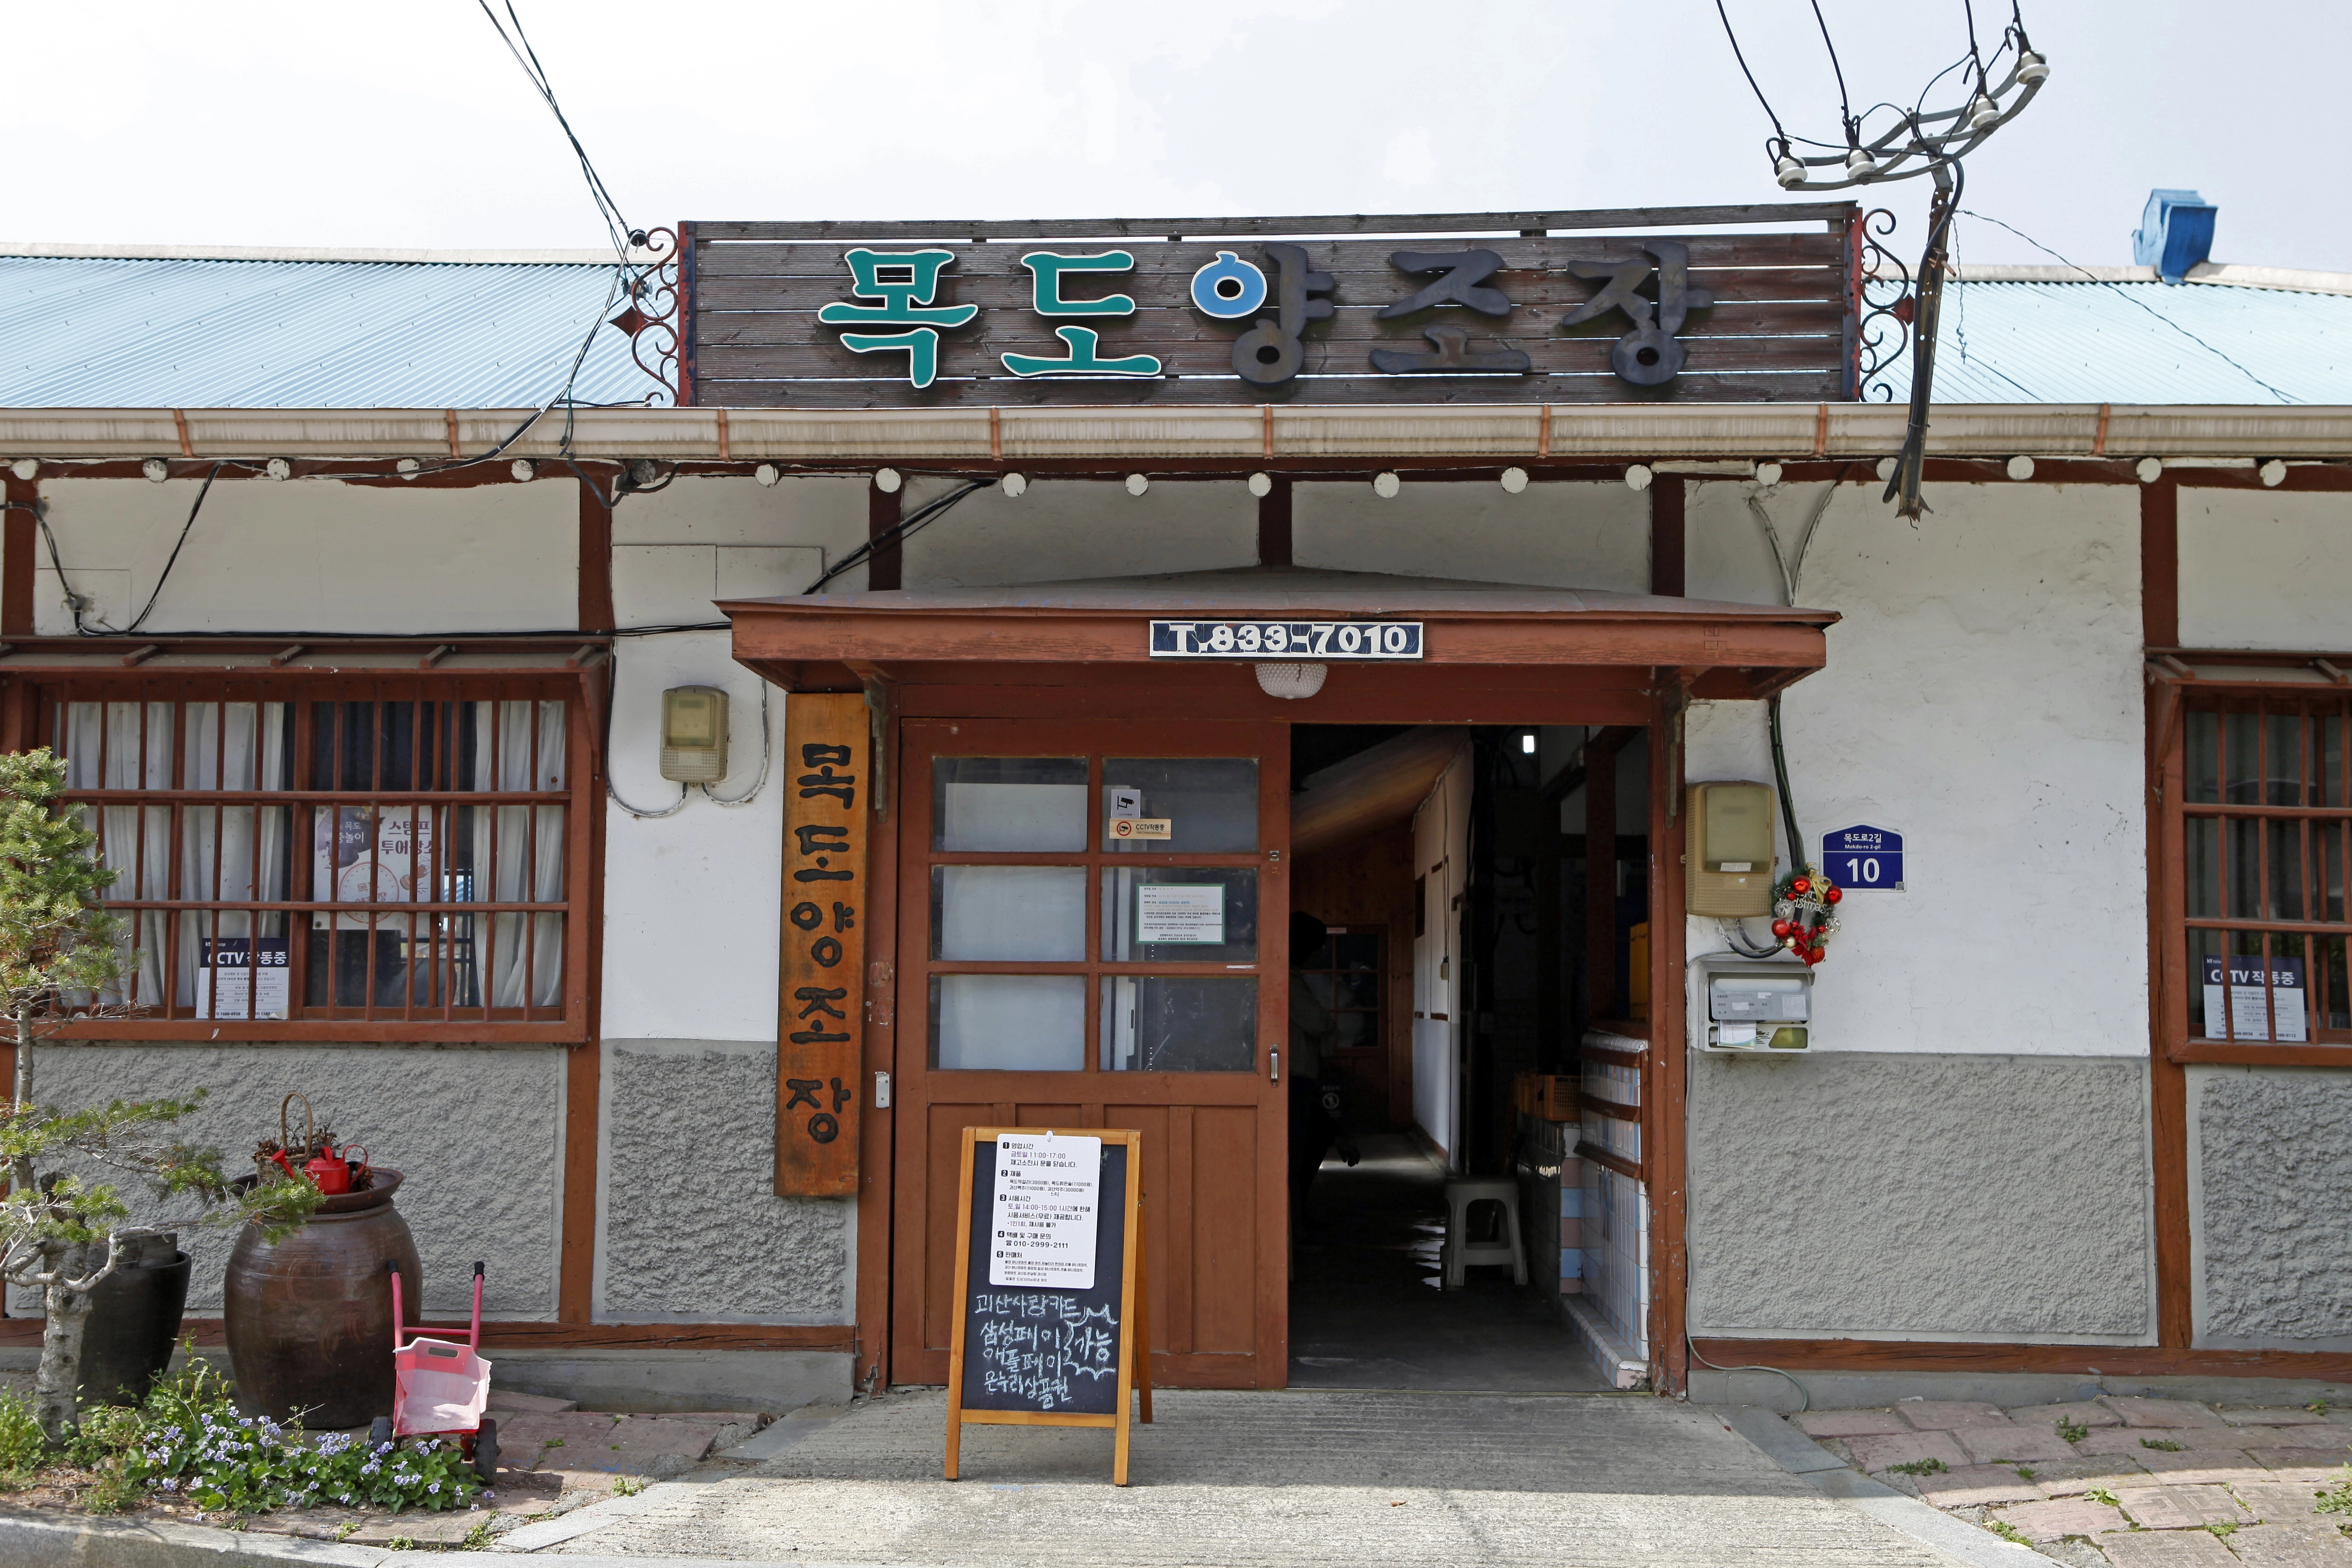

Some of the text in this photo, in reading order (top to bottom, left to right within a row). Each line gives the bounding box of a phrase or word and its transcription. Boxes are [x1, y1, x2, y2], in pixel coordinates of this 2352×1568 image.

[818, 242, 1714, 389] 목도양조장
[345, 821, 361, 831] 목도
[1844, 834, 1882, 843] 목도로2길
[1846, 858, 1880, 882] 10
[1795, 897, 1827, 914] istmas
[2211, 969, 2249, 983] CTV
[1007, 1212, 1052, 1220] 시음서비스(무료)
[1013, 1241, 1068, 1249] 010-2999-2111
[975, 1293, 1082, 1318] 괴산사랑카드
[980, 1320, 1061, 1352] 삼성페이
[1075, 1326, 1113, 1362] 가능
[983, 1346, 1061, 1378] 애플페이
[984, 1370, 1073, 1409] 온누리상품권
